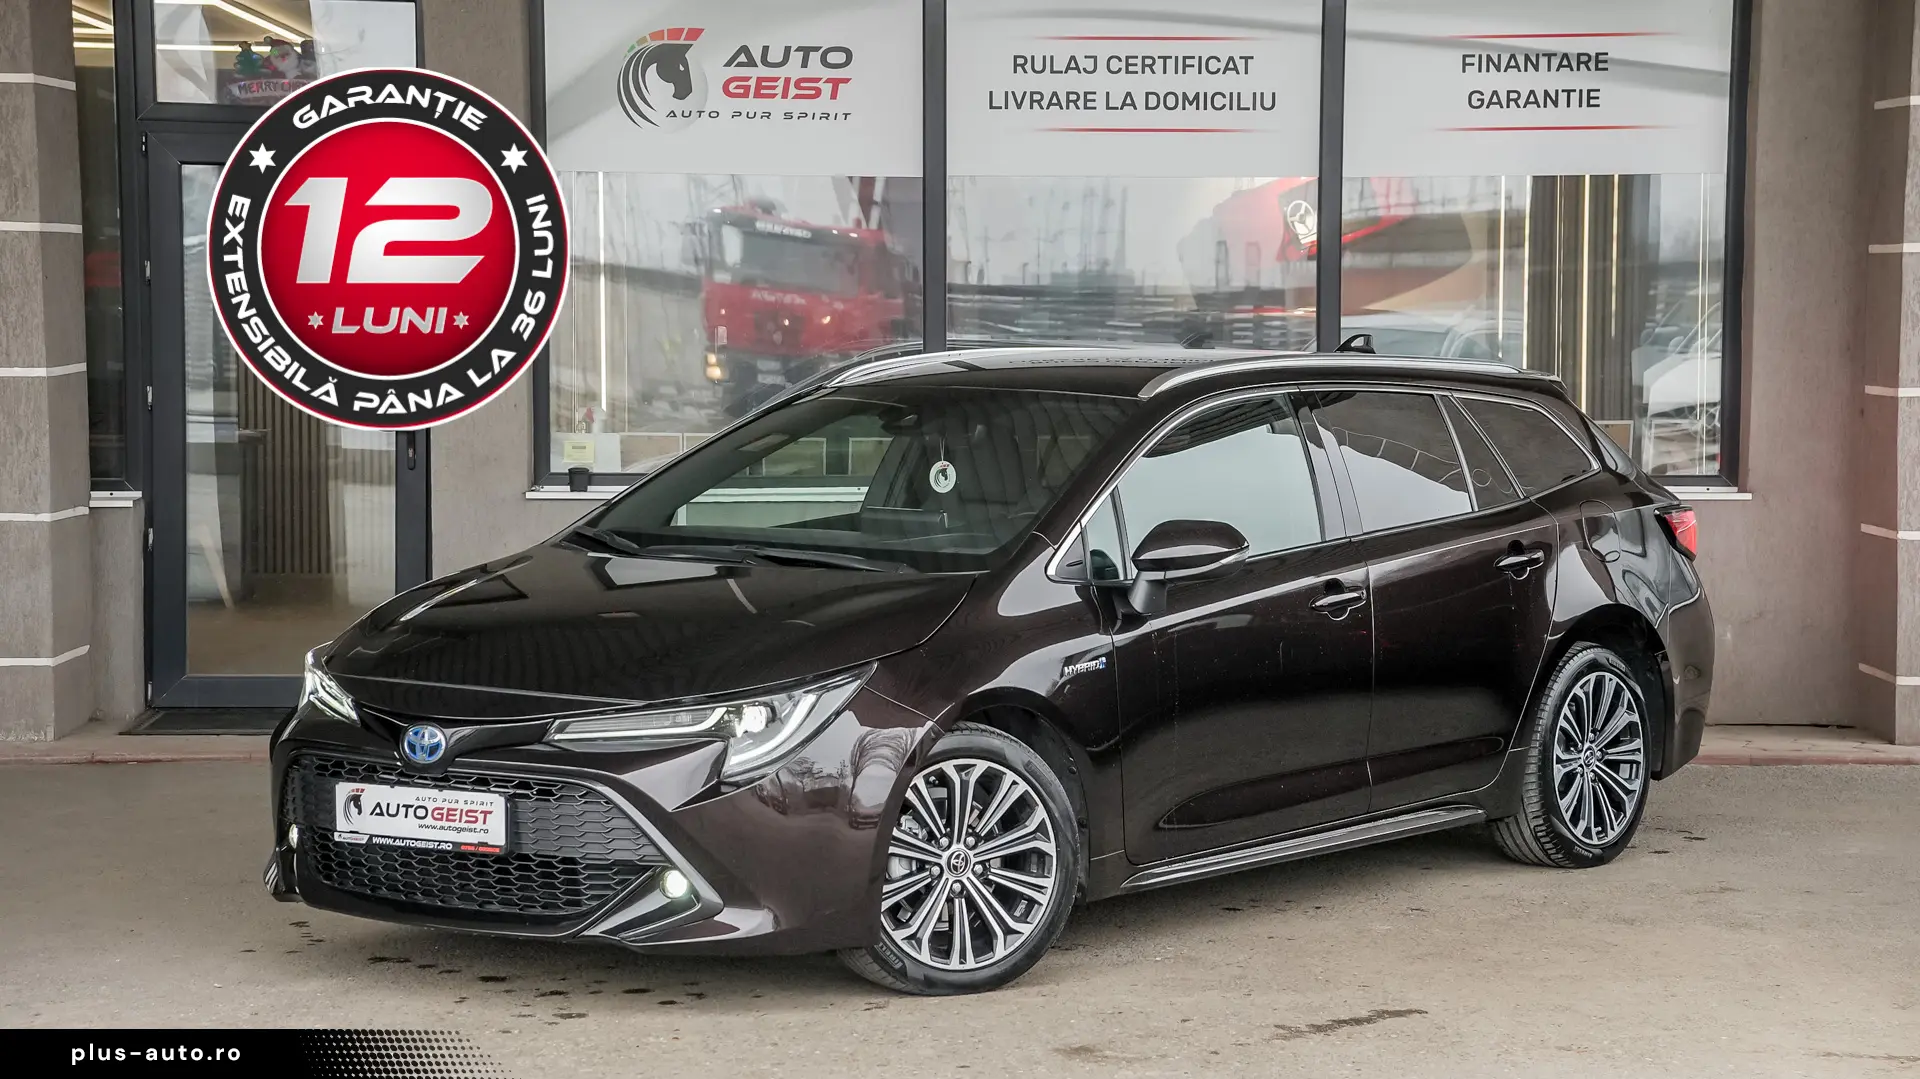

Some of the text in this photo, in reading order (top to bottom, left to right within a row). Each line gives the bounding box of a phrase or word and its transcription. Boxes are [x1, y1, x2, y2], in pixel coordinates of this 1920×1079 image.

[722, 44, 854, 70] AUTO
[1013, 55, 1255, 75] RULAJ CERTIFICAT
[1461, 51, 1609, 74] FINANTARE
[721, 75, 853, 101] GEIST
[988, 91, 1276, 111] LIVRARE LA DOMICILIU
[1467, 88, 1601, 110] GARANTIE
[665, 109, 852, 121] AUTO PUR SPIRIT
[1064, 660, 1100, 675] HYBRID
[418, 823, 489, 834] www.autogeist.ro
[372, 836, 453, 850] WWW.AUTOGEIST.RO
